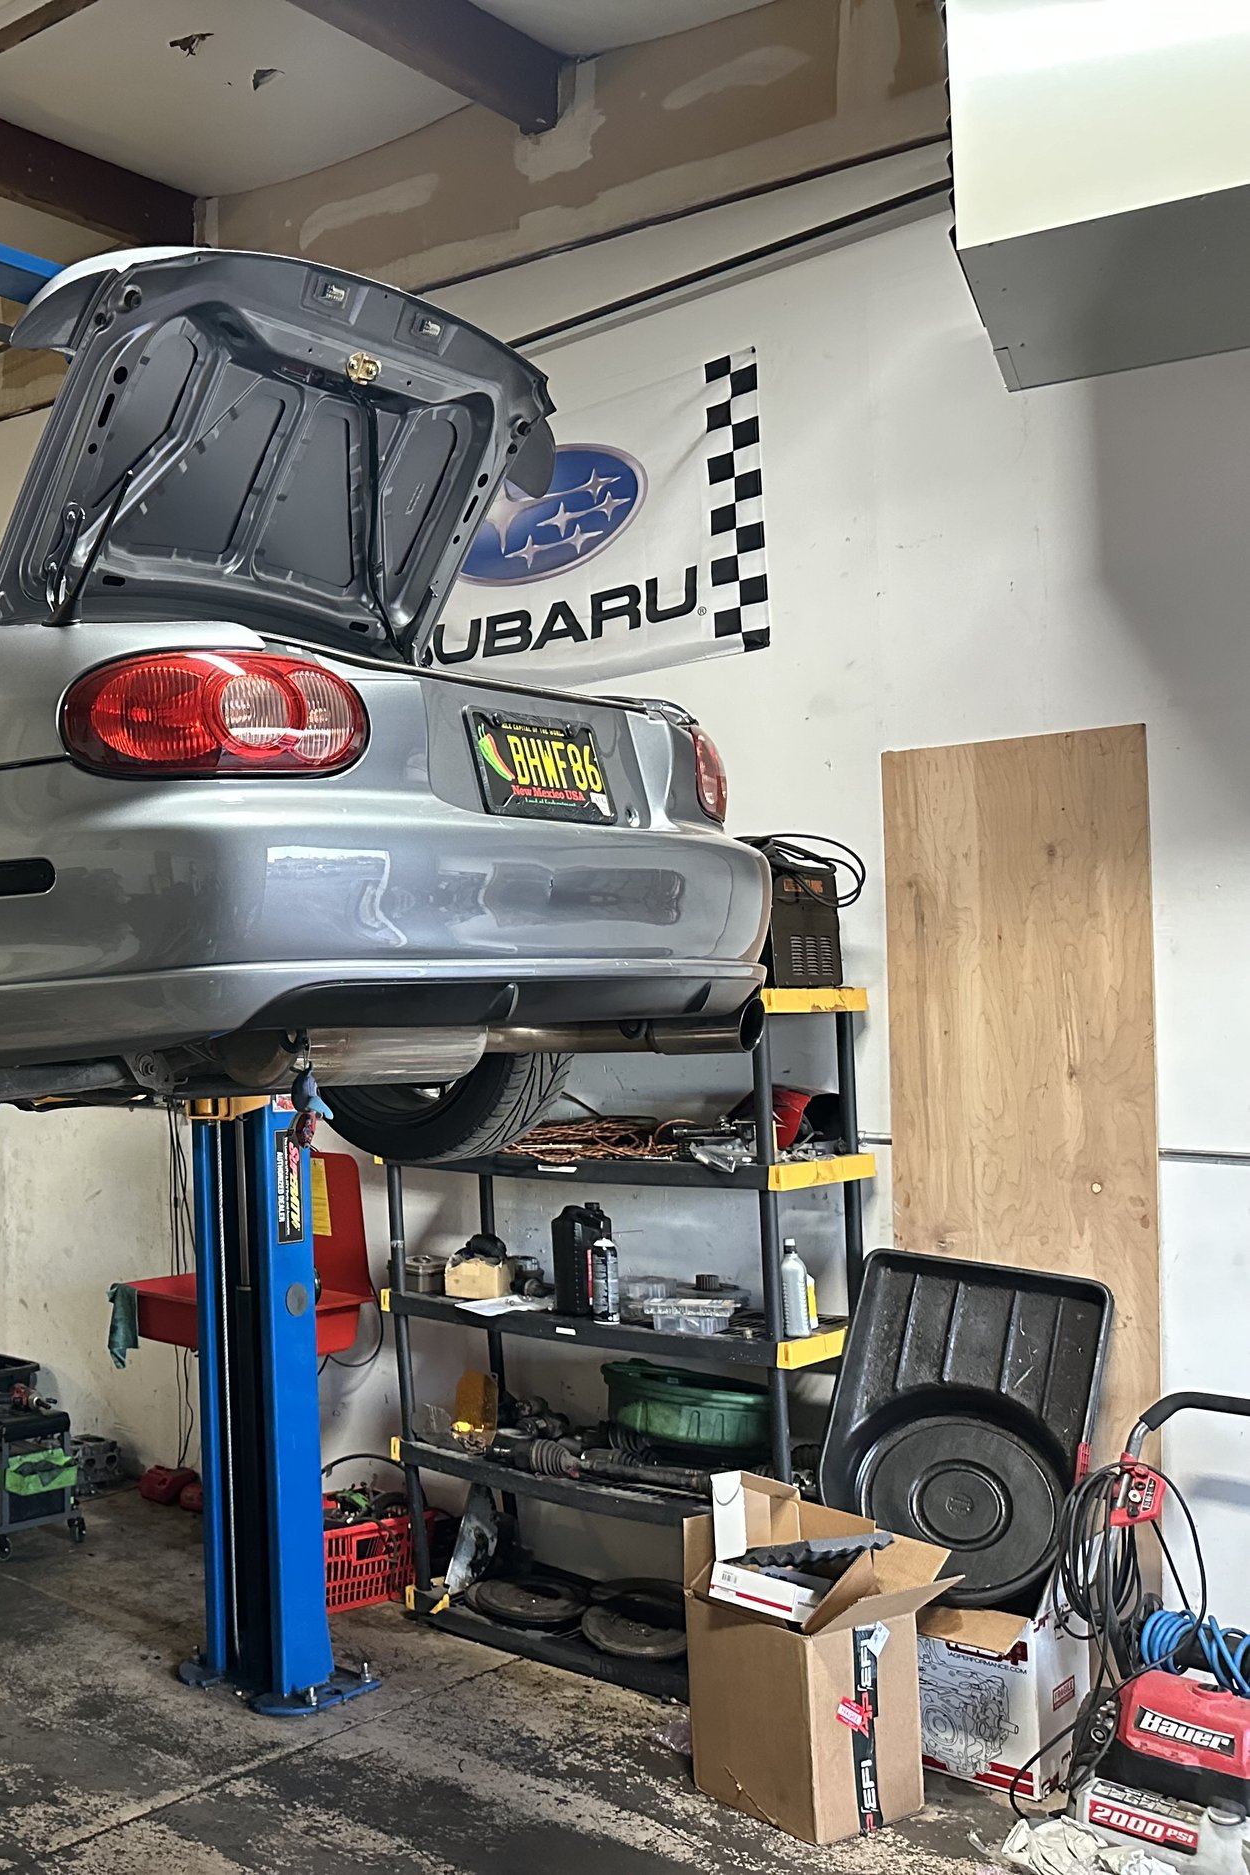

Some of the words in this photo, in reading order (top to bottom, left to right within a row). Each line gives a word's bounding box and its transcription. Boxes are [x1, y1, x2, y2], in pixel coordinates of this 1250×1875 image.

[423, 565, 697, 665] UBARU
[507, 735, 604, 793] BHWF86
[511, 785, 533, 797] New
[533, 787, 565, 800] Mexico
[565, 790, 586, 801] USA
[276, 1151, 284, 1195] AUTHORIZED
[278, 1195, 286, 1223] DEALER
[948, 1652, 1027, 1675] IAGPERFORMANCE.COM
[1139, 1711, 1230, 1750] Bauer
[1092, 1805, 1164, 1838] 2000
[1166, 1827, 1194, 1844] PSI
